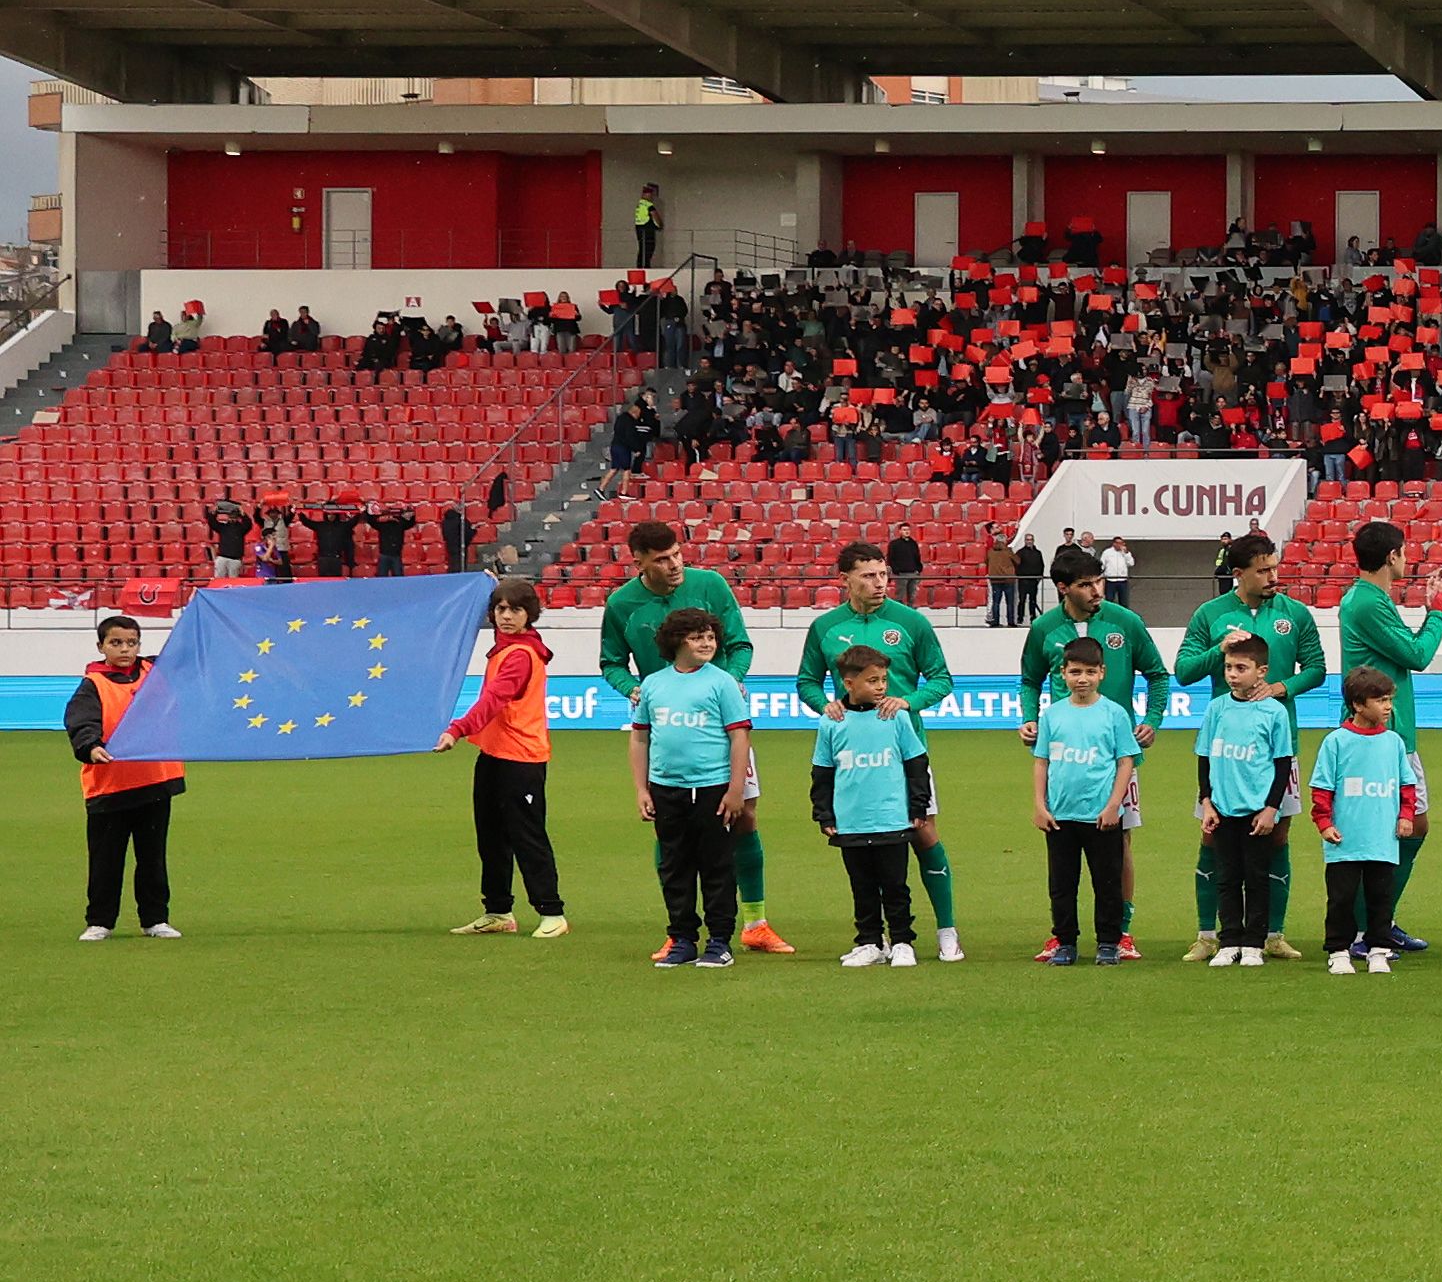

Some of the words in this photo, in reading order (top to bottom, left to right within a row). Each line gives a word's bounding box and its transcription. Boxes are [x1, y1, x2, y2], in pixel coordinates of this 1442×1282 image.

[854, 748, 893, 768] cuf
[1064, 746, 1098, 766] cuf
[1364, 778, 1396, 798] cuf
